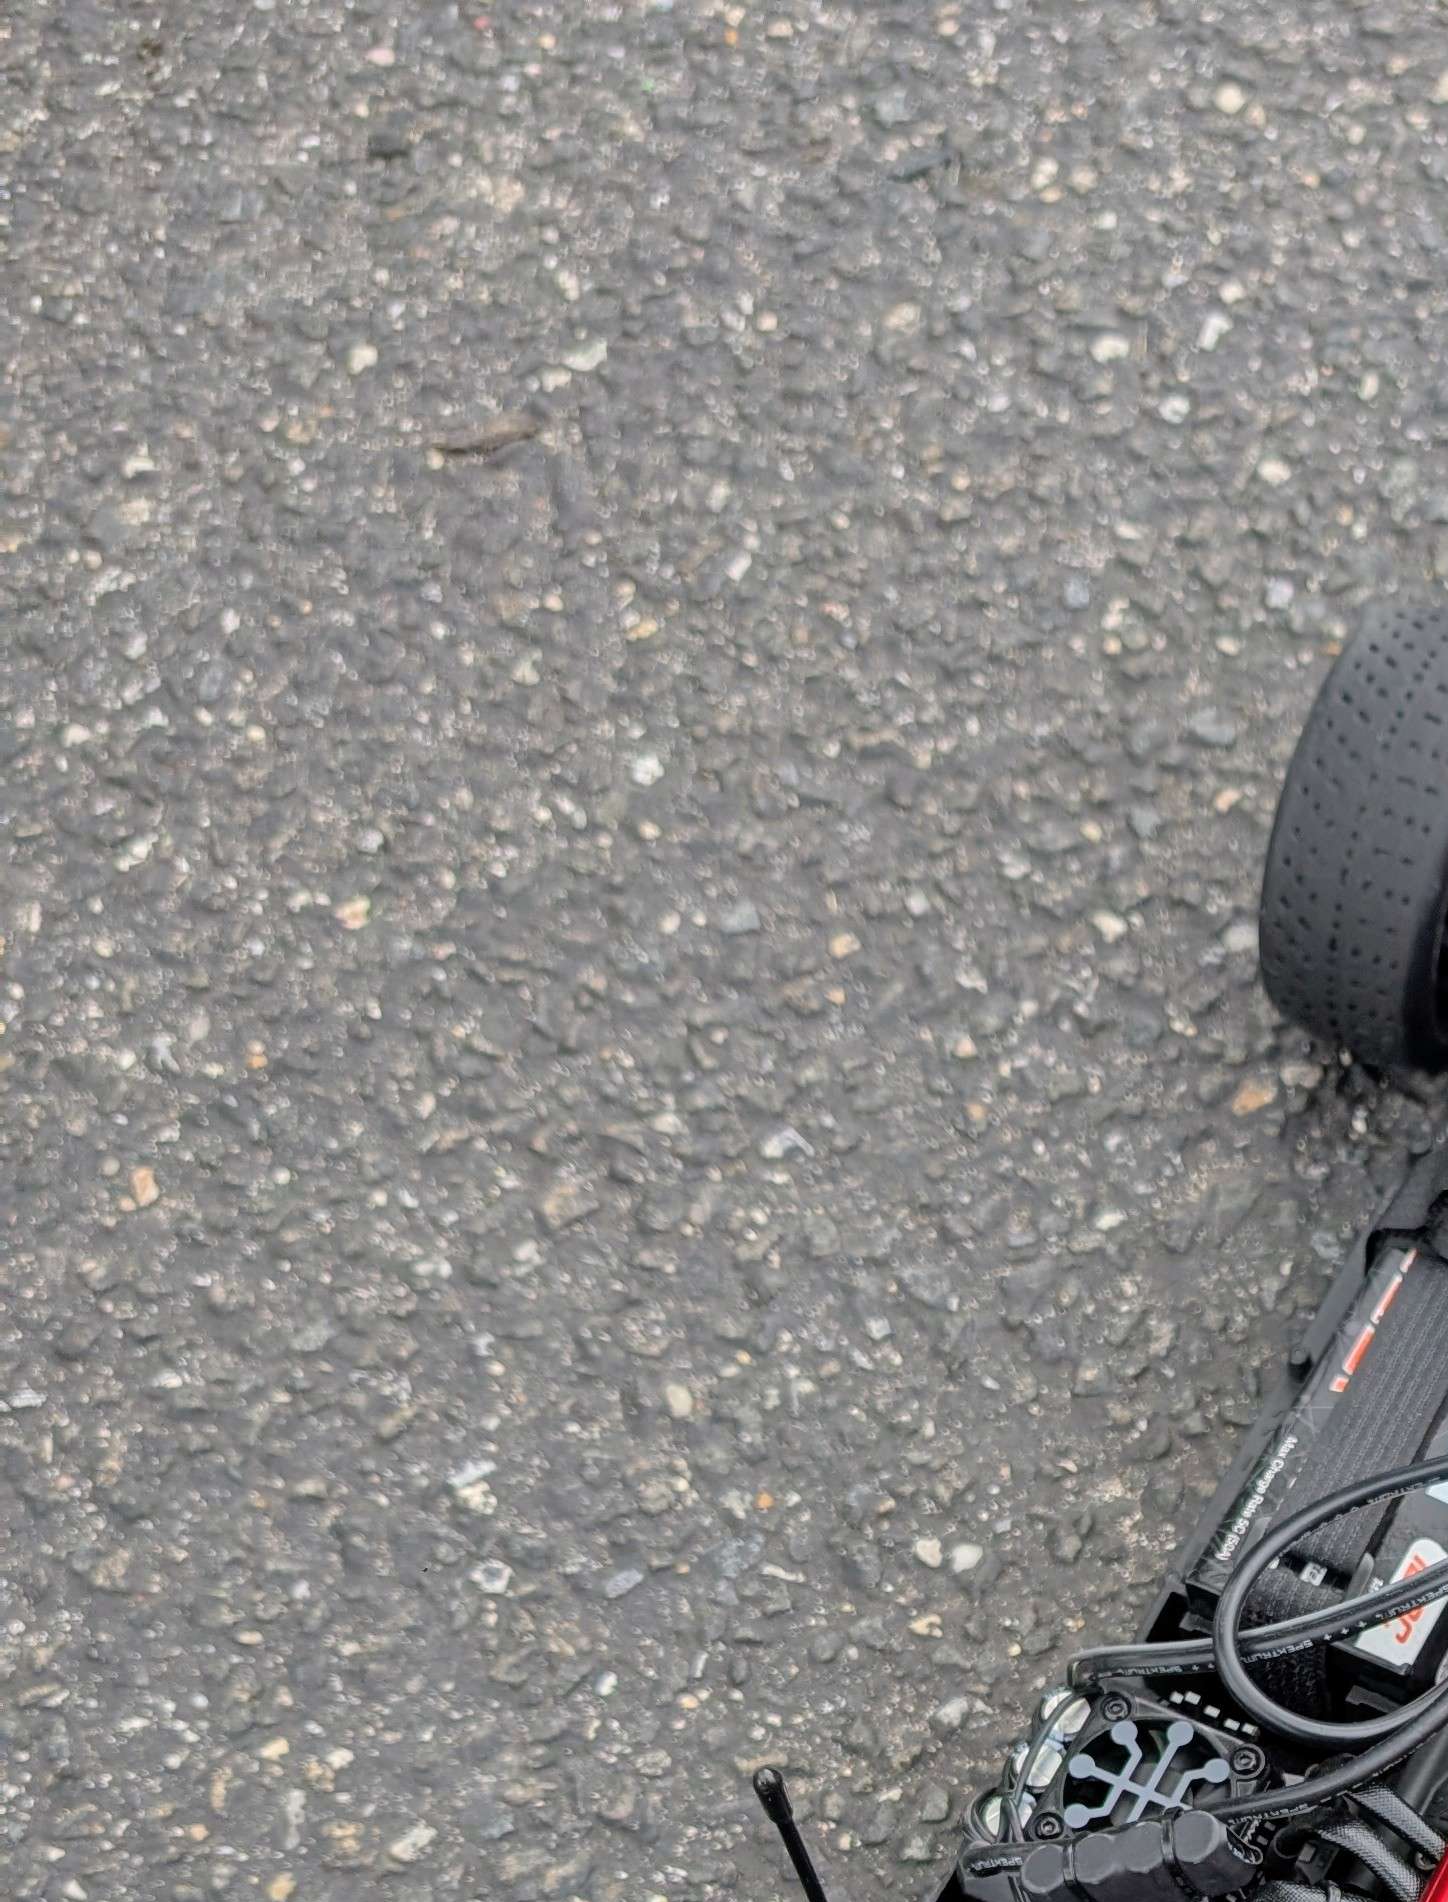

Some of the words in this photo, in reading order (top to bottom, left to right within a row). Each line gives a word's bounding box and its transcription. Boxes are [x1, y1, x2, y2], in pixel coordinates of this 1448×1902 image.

[1278, 1436, 1298, 1459] Max
[1255, 1459, 1285, 1494] Charge
[1241, 1494, 1264, 1518] Rate
